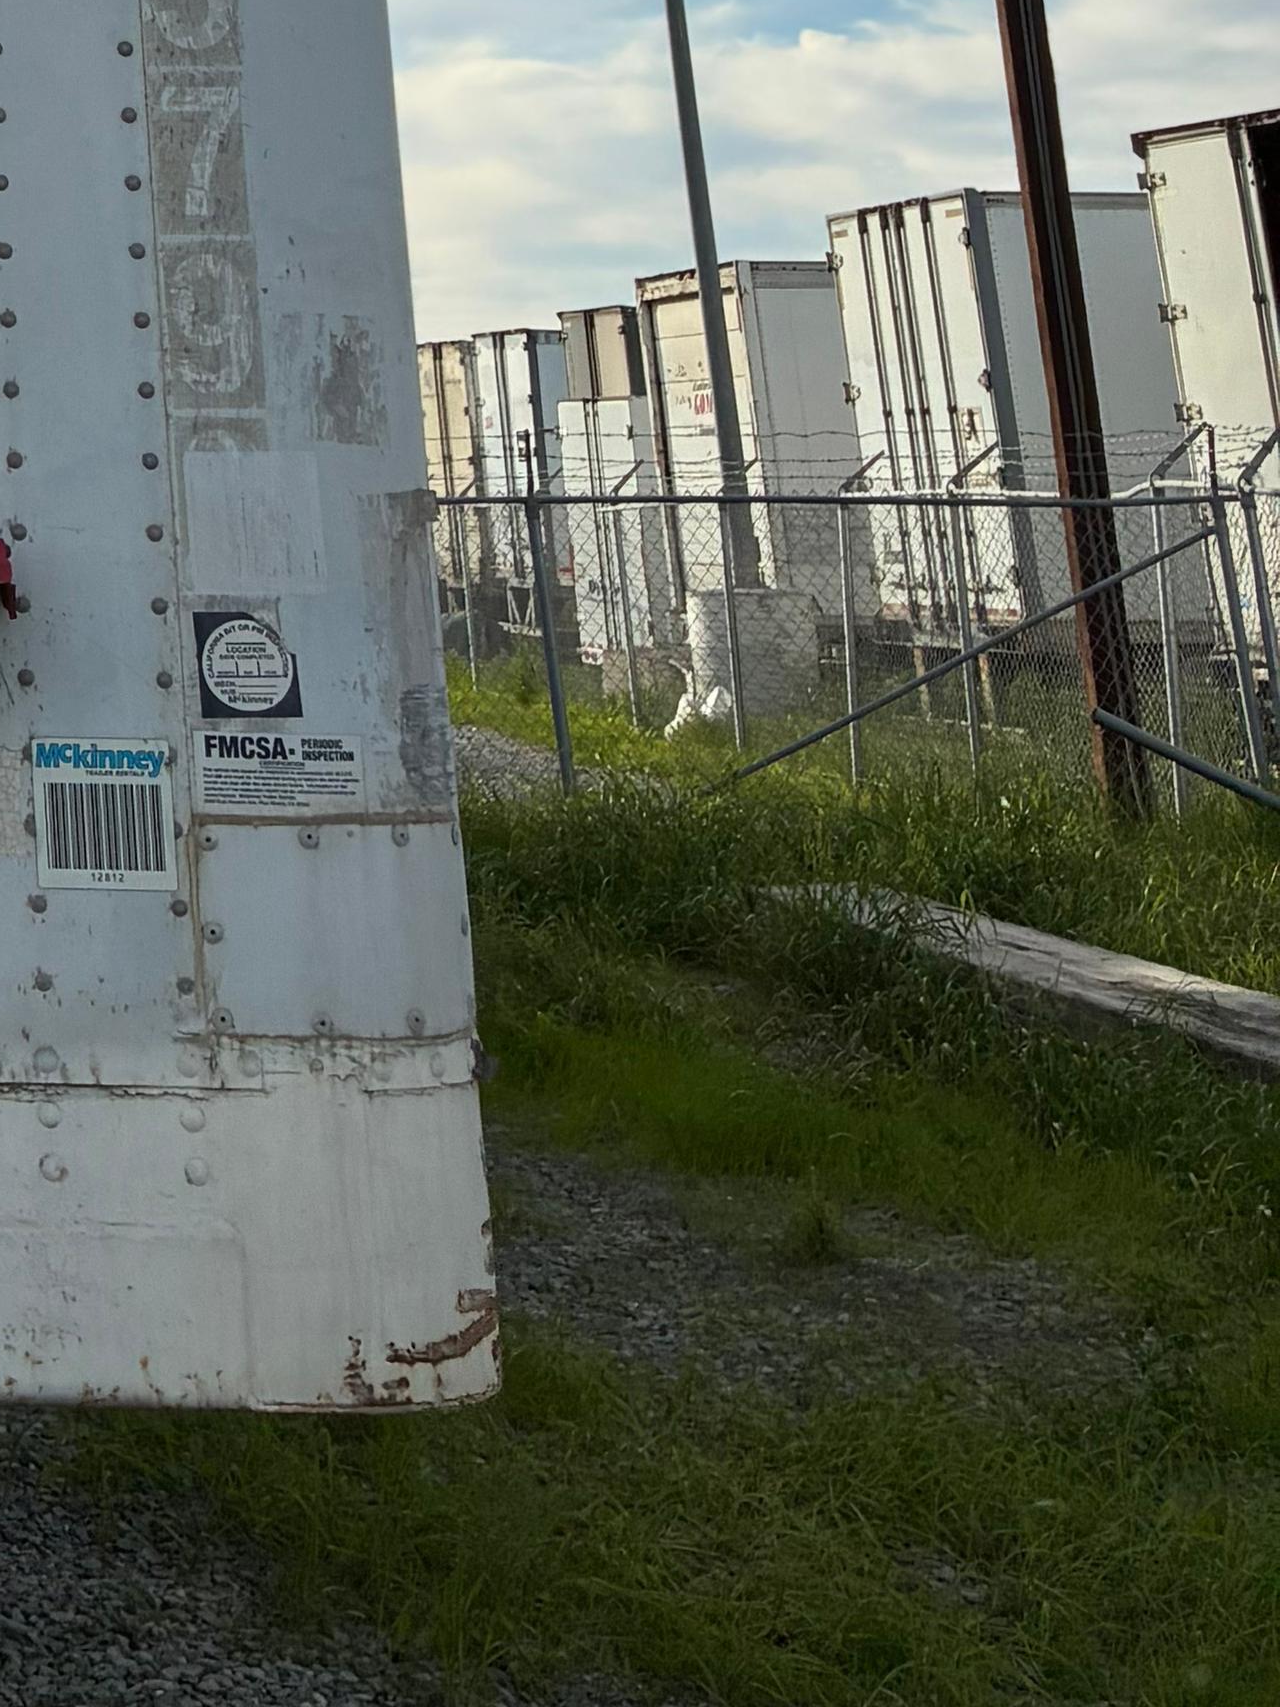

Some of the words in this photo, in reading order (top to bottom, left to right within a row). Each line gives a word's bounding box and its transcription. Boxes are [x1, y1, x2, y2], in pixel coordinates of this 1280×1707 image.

[226, 645, 267, 654] LOCATION
[301, 738, 343, 750] PERIODIC
[301, 750, 355, 762] INSPECTION
